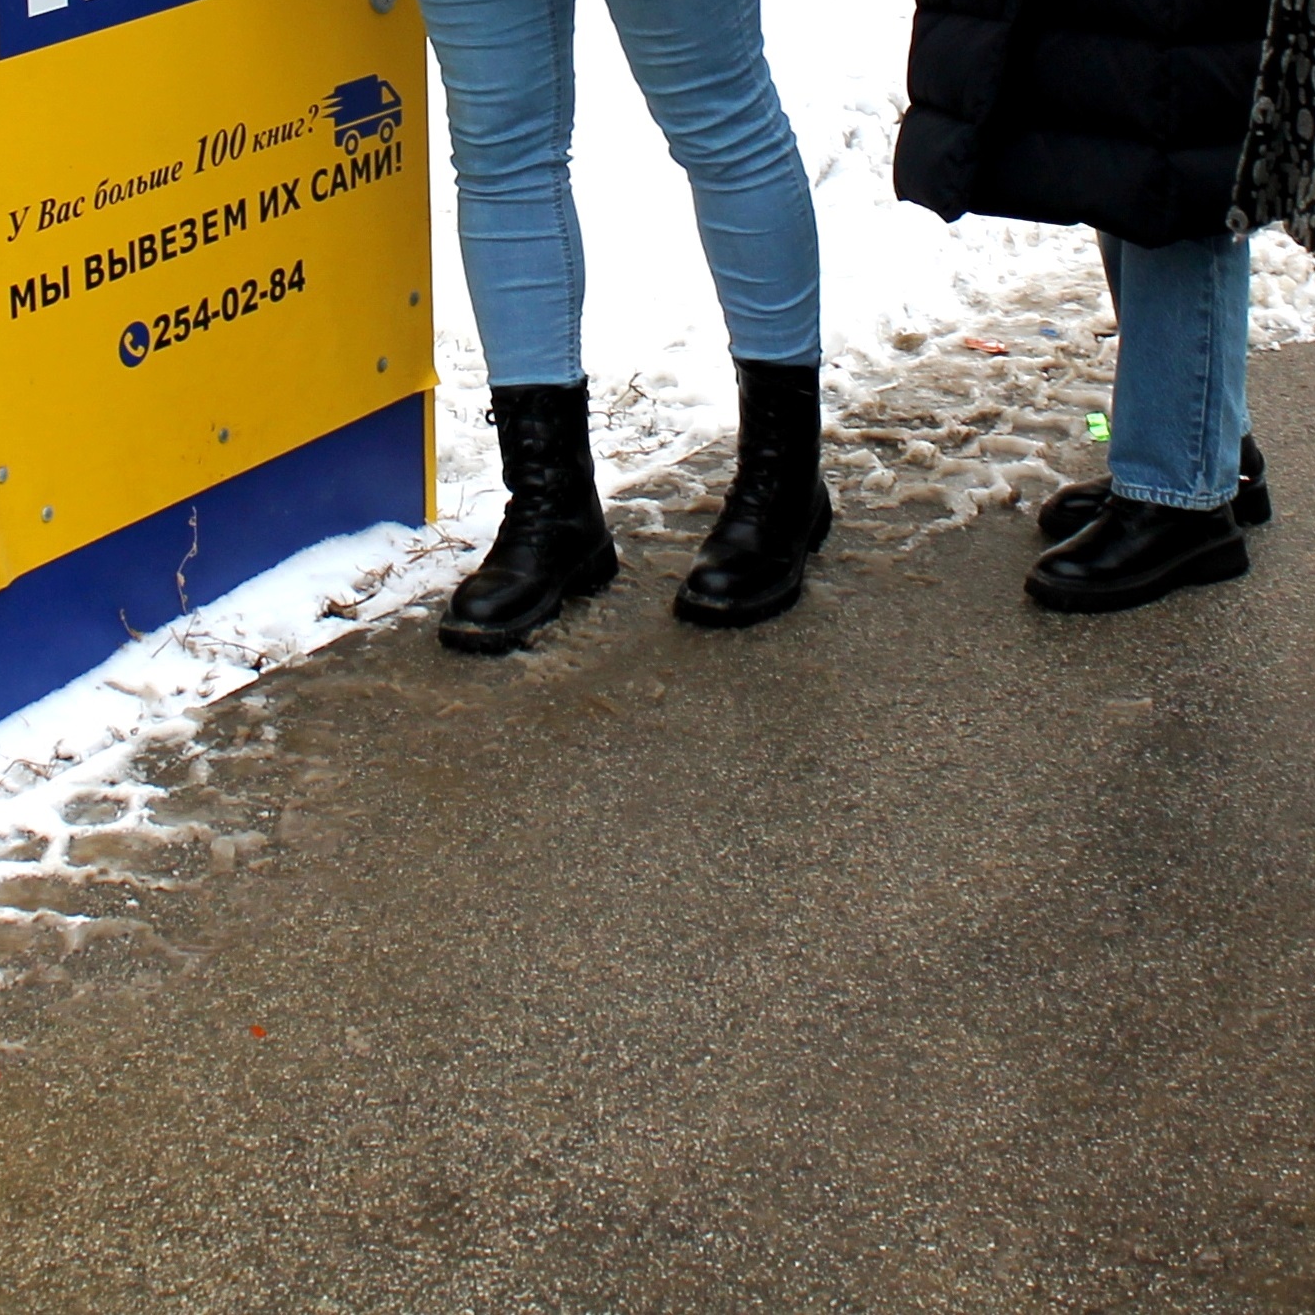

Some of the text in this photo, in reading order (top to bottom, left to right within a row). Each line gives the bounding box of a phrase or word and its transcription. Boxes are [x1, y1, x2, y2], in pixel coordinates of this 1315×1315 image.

[6, 103, 321, 243] У Вас больше 100 книг?
[8, 140, 404, 321] МЫ ВЫВЕЗЕМ ИХ САМИ!
[151, 258, 307, 353] 254-02-84
